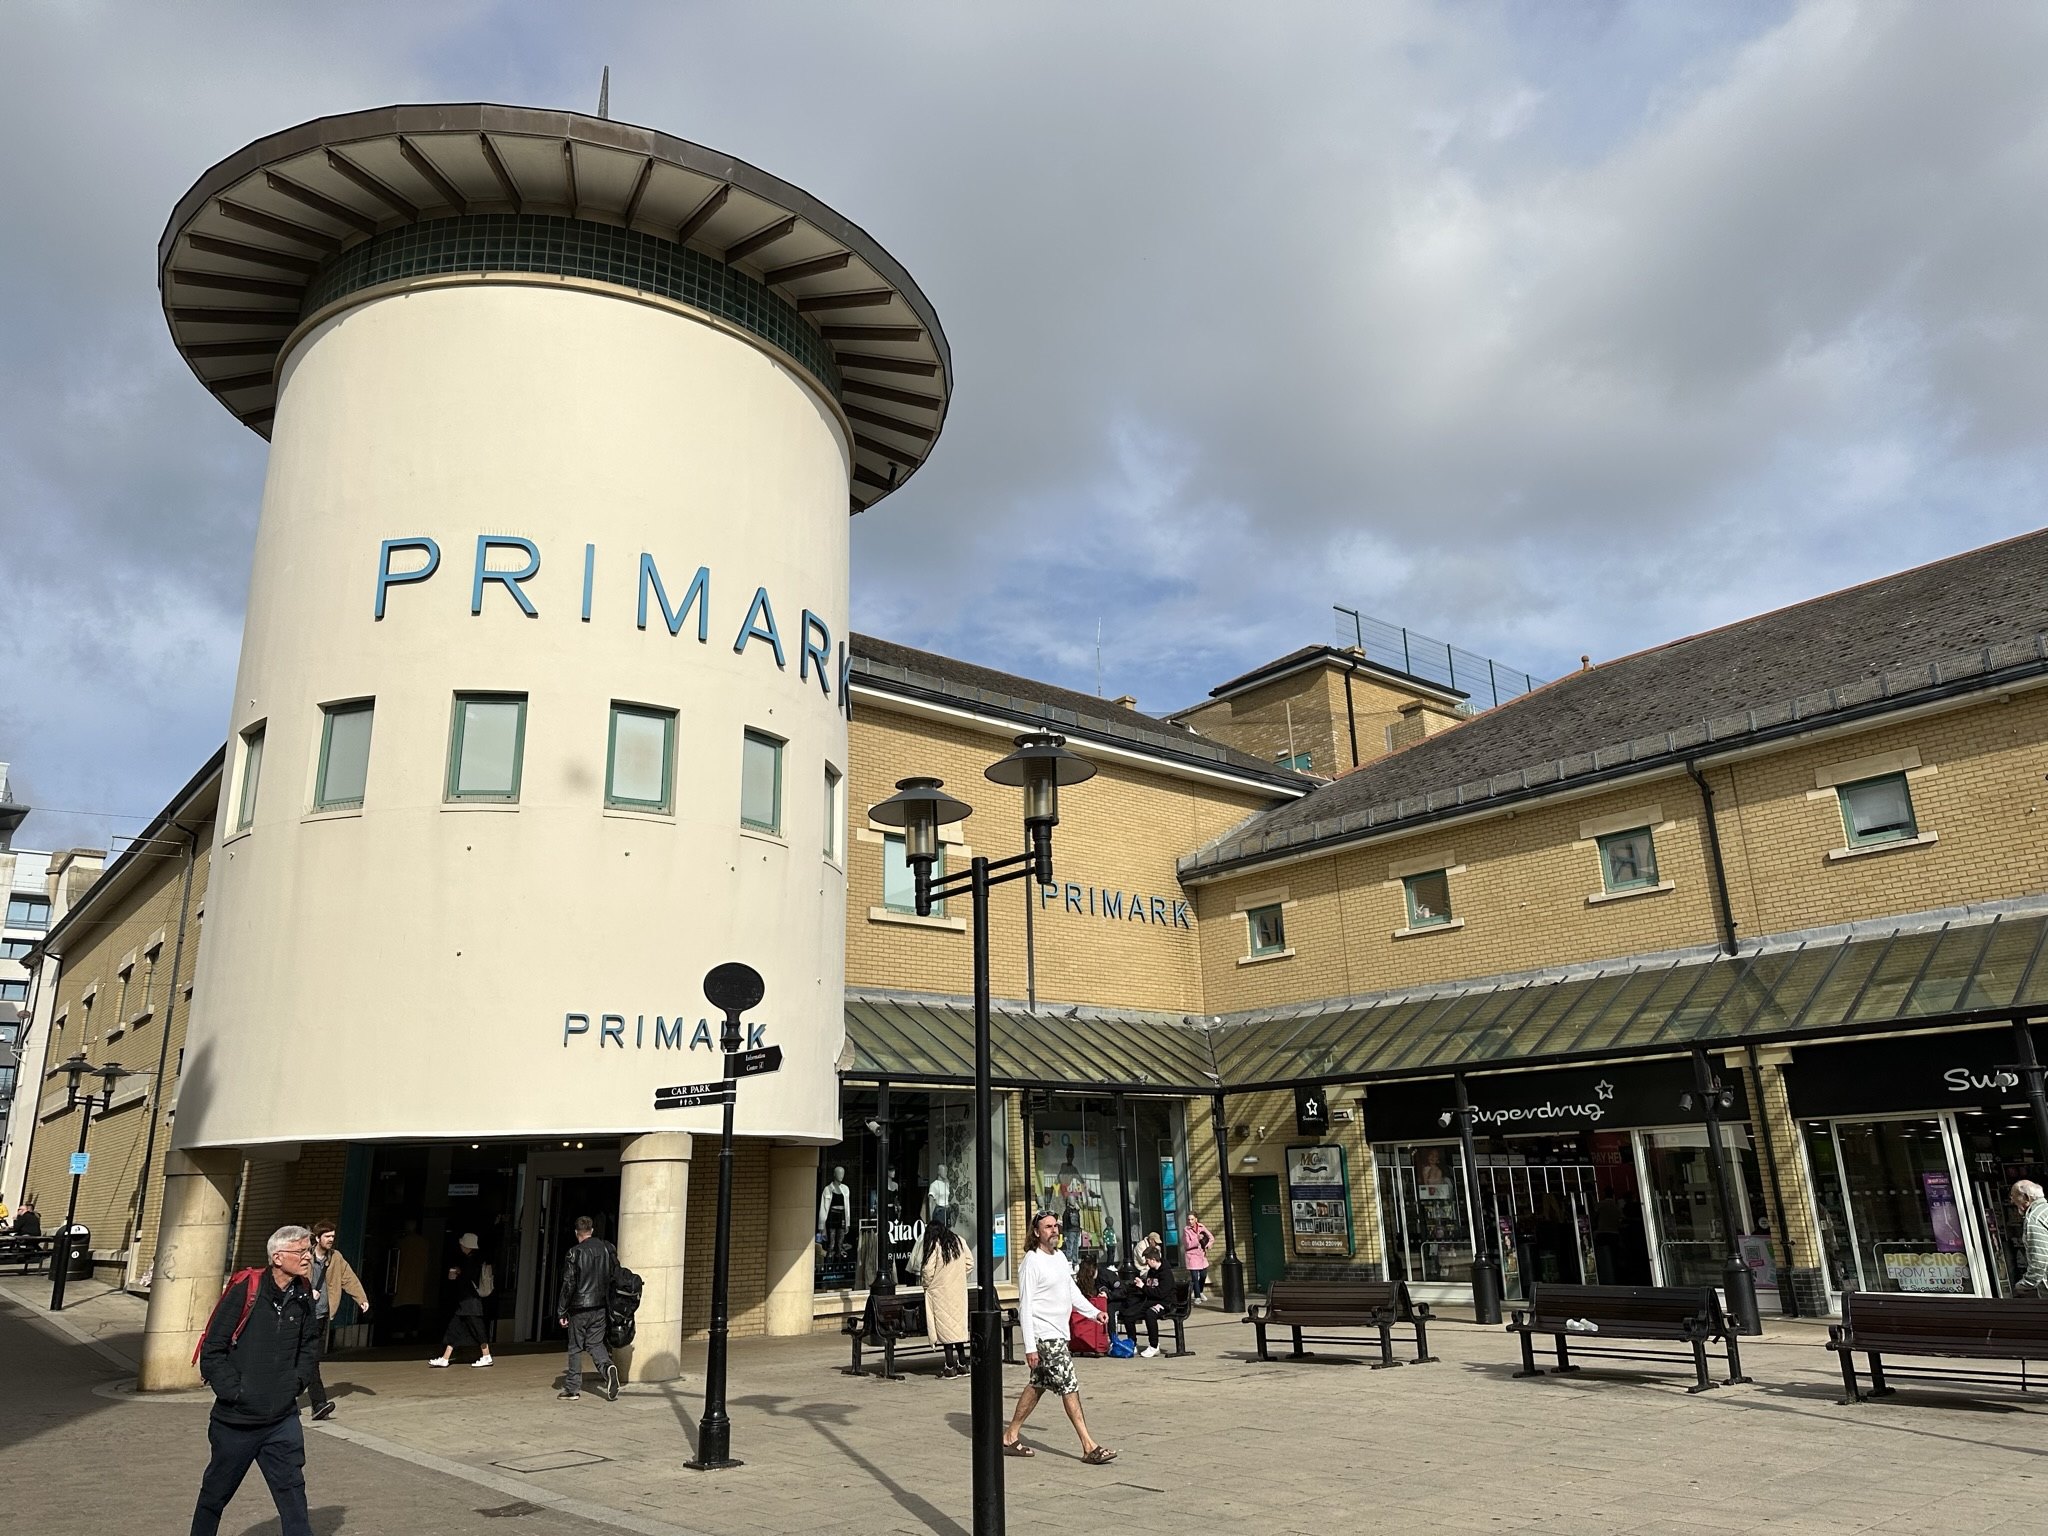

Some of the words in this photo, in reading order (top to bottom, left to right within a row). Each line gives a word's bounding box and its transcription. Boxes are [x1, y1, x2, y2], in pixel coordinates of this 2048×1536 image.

[375, 534, 853, 722] PRIMARK
[1041, 880, 1190, 929] PRIMARK
[563, 1012, 767, 1052] PRIMAK
[671, 1087, 687, 1096] CAR
[690, 1084, 711, 1093] PARK
[1467, 1101, 1605, 1126] Superdrug
[888, 1219, 913, 1244] Rita
[1884, 1253, 1968, 1267] PIERCING
[1888, 1267, 1926, 1278] FROM
[1928, 1266, 1970, 1278] £11.50
